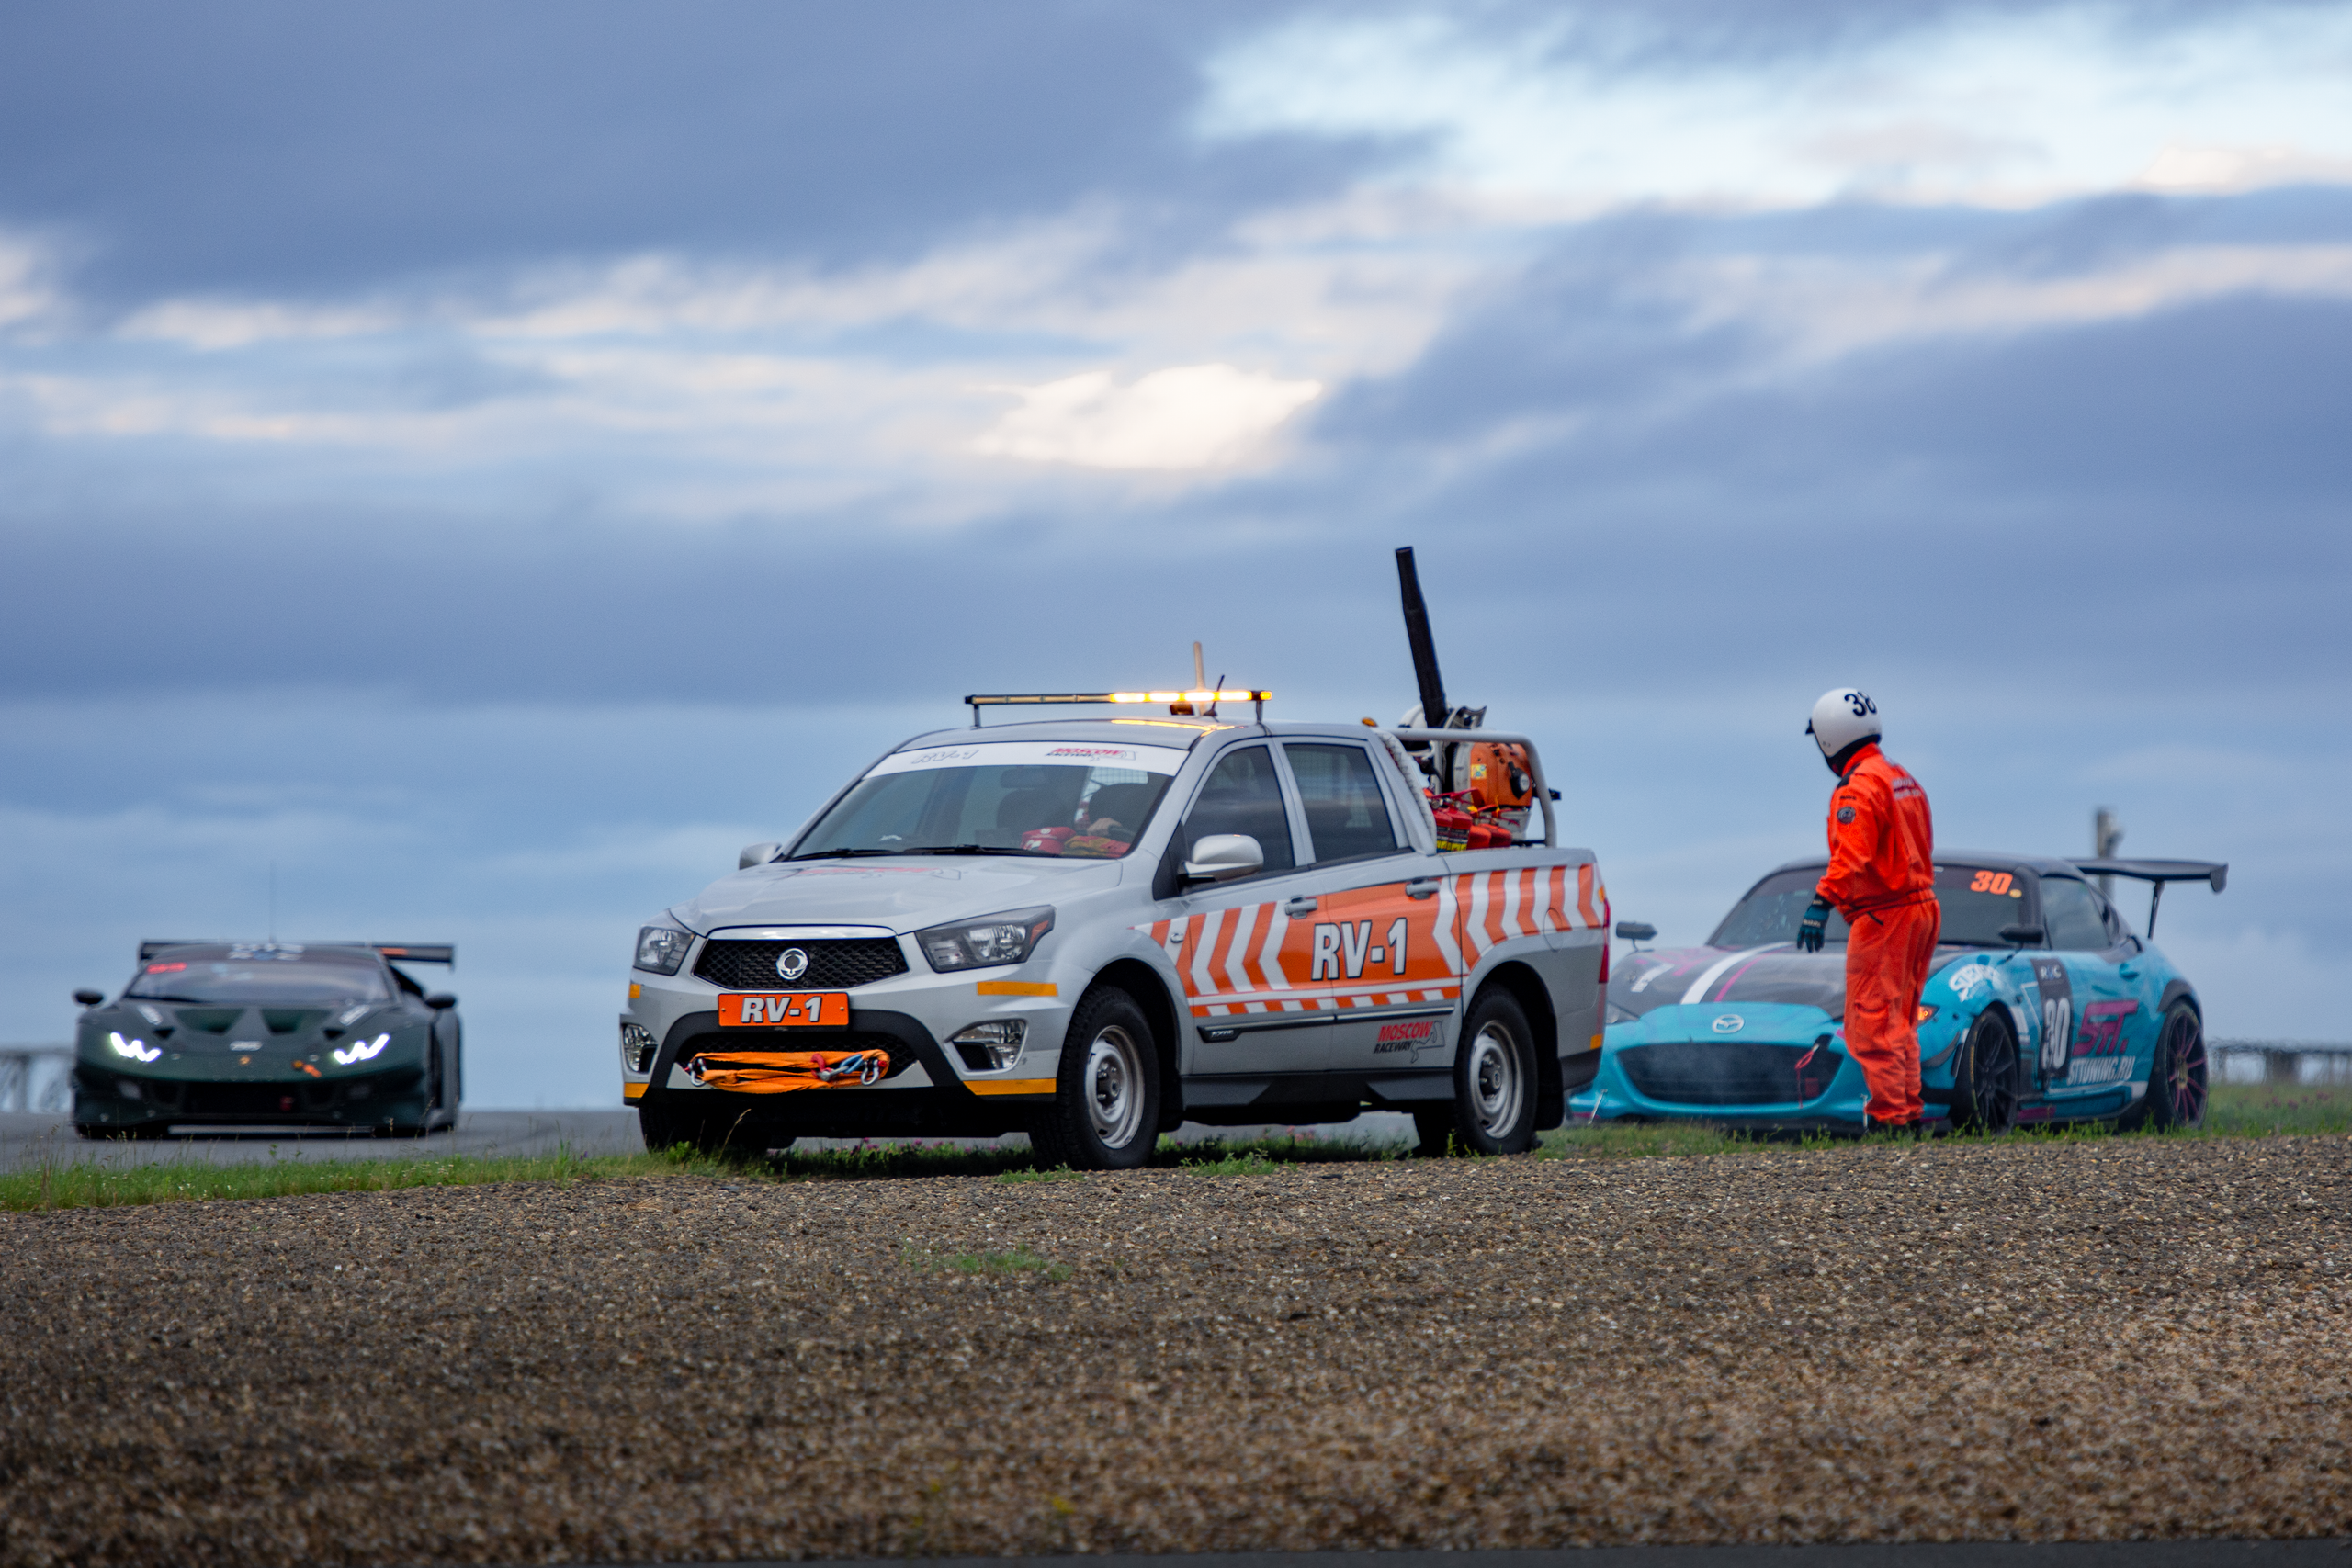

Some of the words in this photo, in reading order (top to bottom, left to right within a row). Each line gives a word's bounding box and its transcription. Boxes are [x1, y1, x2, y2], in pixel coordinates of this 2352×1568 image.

[1971, 870, 2013, 895] 30
[1311, 917, 1408, 981] RV-1
[741, 996, 823, 1023] RV-1
[1377, 1021, 1434, 1042] MOSCOW
[1374, 1040, 1413, 1054] RACEWAY
